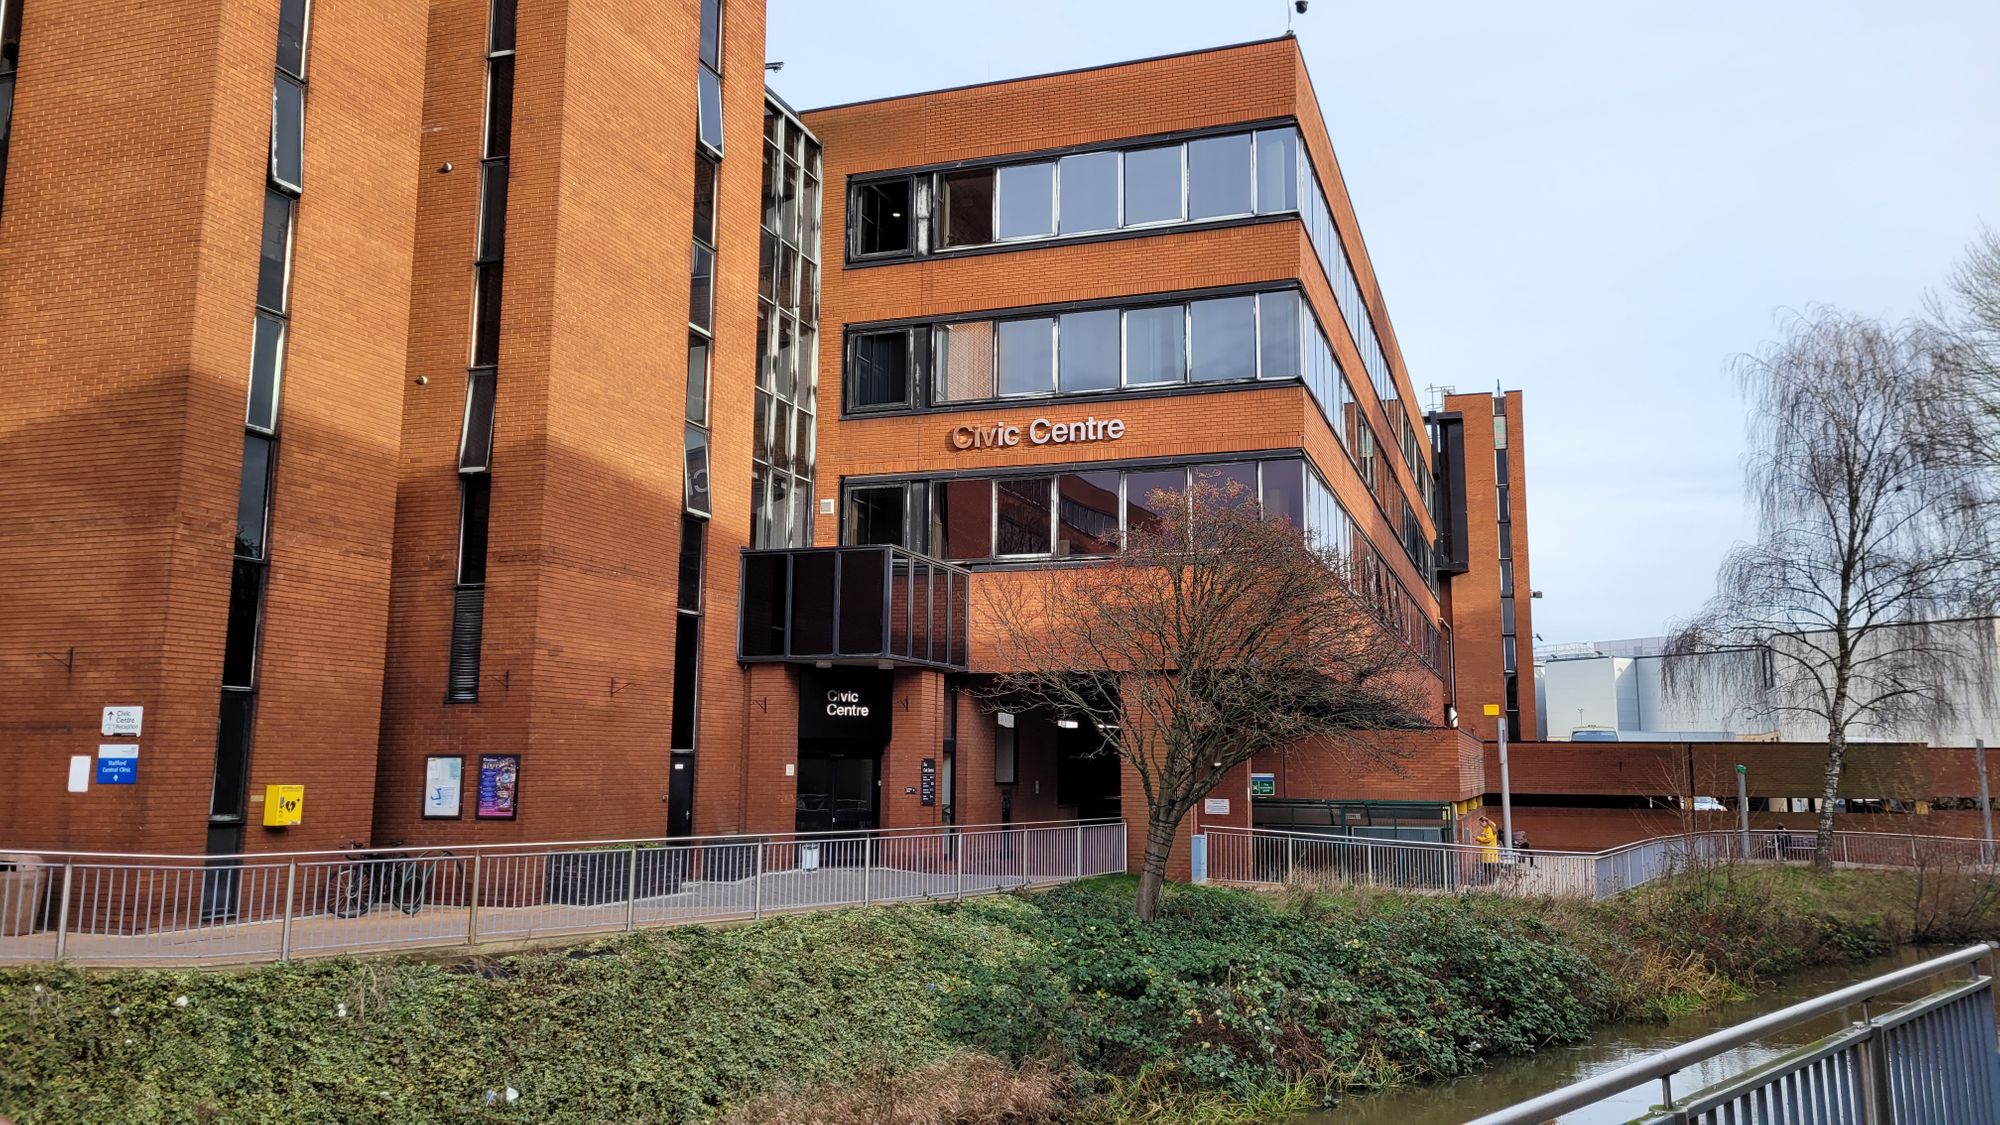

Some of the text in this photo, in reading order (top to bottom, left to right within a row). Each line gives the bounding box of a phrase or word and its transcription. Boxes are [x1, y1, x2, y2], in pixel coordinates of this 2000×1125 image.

[952, 416, 1125, 449] Civic Centre
[827, 689, 859, 702] Civic
[826, 703, 869, 716] Centre
